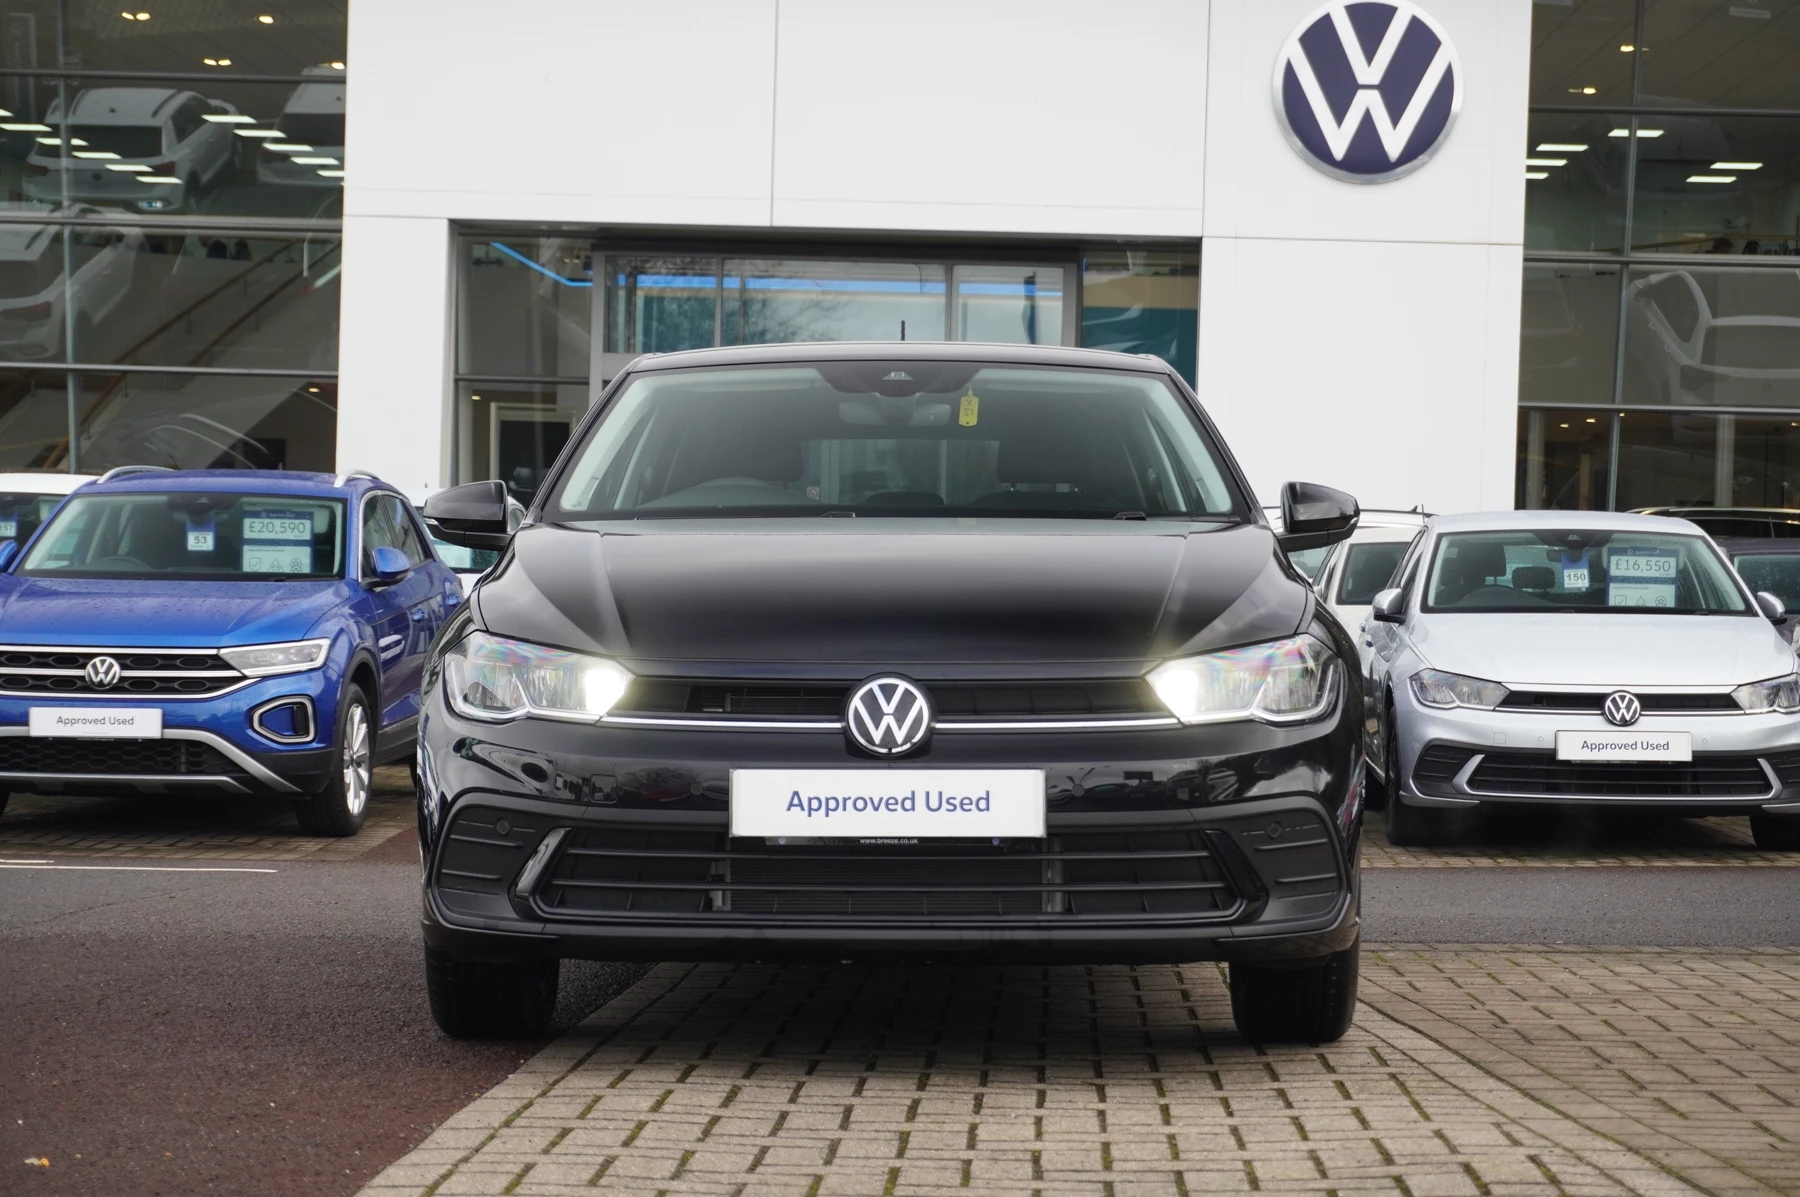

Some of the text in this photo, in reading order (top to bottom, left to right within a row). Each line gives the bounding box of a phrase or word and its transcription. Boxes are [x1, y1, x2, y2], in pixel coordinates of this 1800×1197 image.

[1276, 0, 1459, 174] VW
[248, 521, 306, 535] £20,590
[193, 535, 207, 545] 53
[1614, 558, 1671, 573] £16,550
[1566, 572, 1587, 582] 150
[85, 656, 121, 690] VW
[847, 677, 930, 754] VW
[1604, 691, 1641, 725] VW
[56, 716, 134, 727] Approved Used
[1581, 740, 1670, 752] Approved Used
[786, 790, 990, 818] Approved Used
